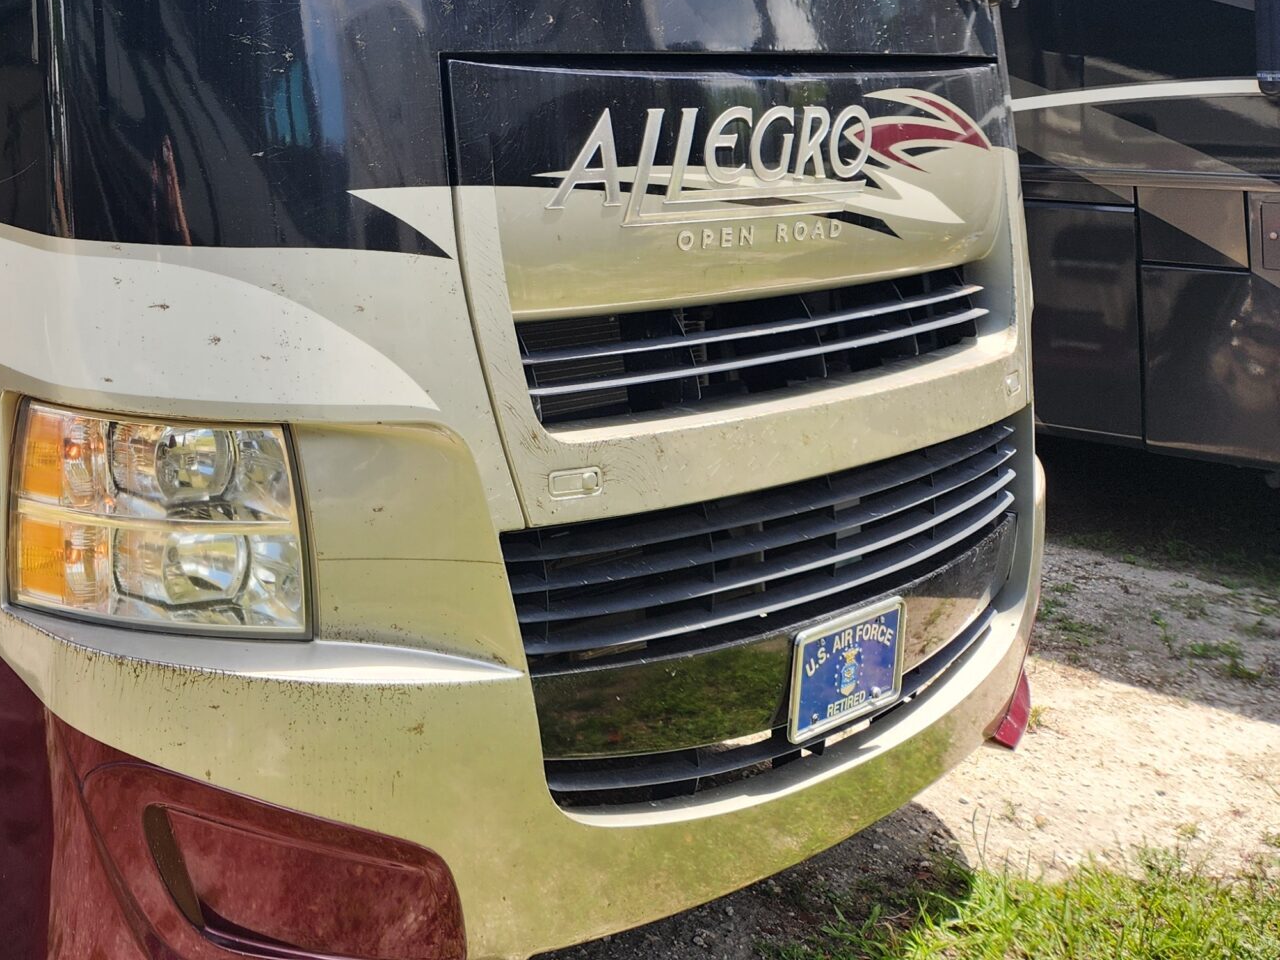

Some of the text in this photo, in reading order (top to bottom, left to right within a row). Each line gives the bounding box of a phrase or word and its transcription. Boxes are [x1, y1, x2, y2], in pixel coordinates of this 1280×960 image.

[545, 104, 873, 227] ALLEGRO
[677, 219, 843, 252] OPEN ROAD
[805, 623, 894, 677] U.S. AIR FORCE
[826, 690, 866, 718] RETIRED
